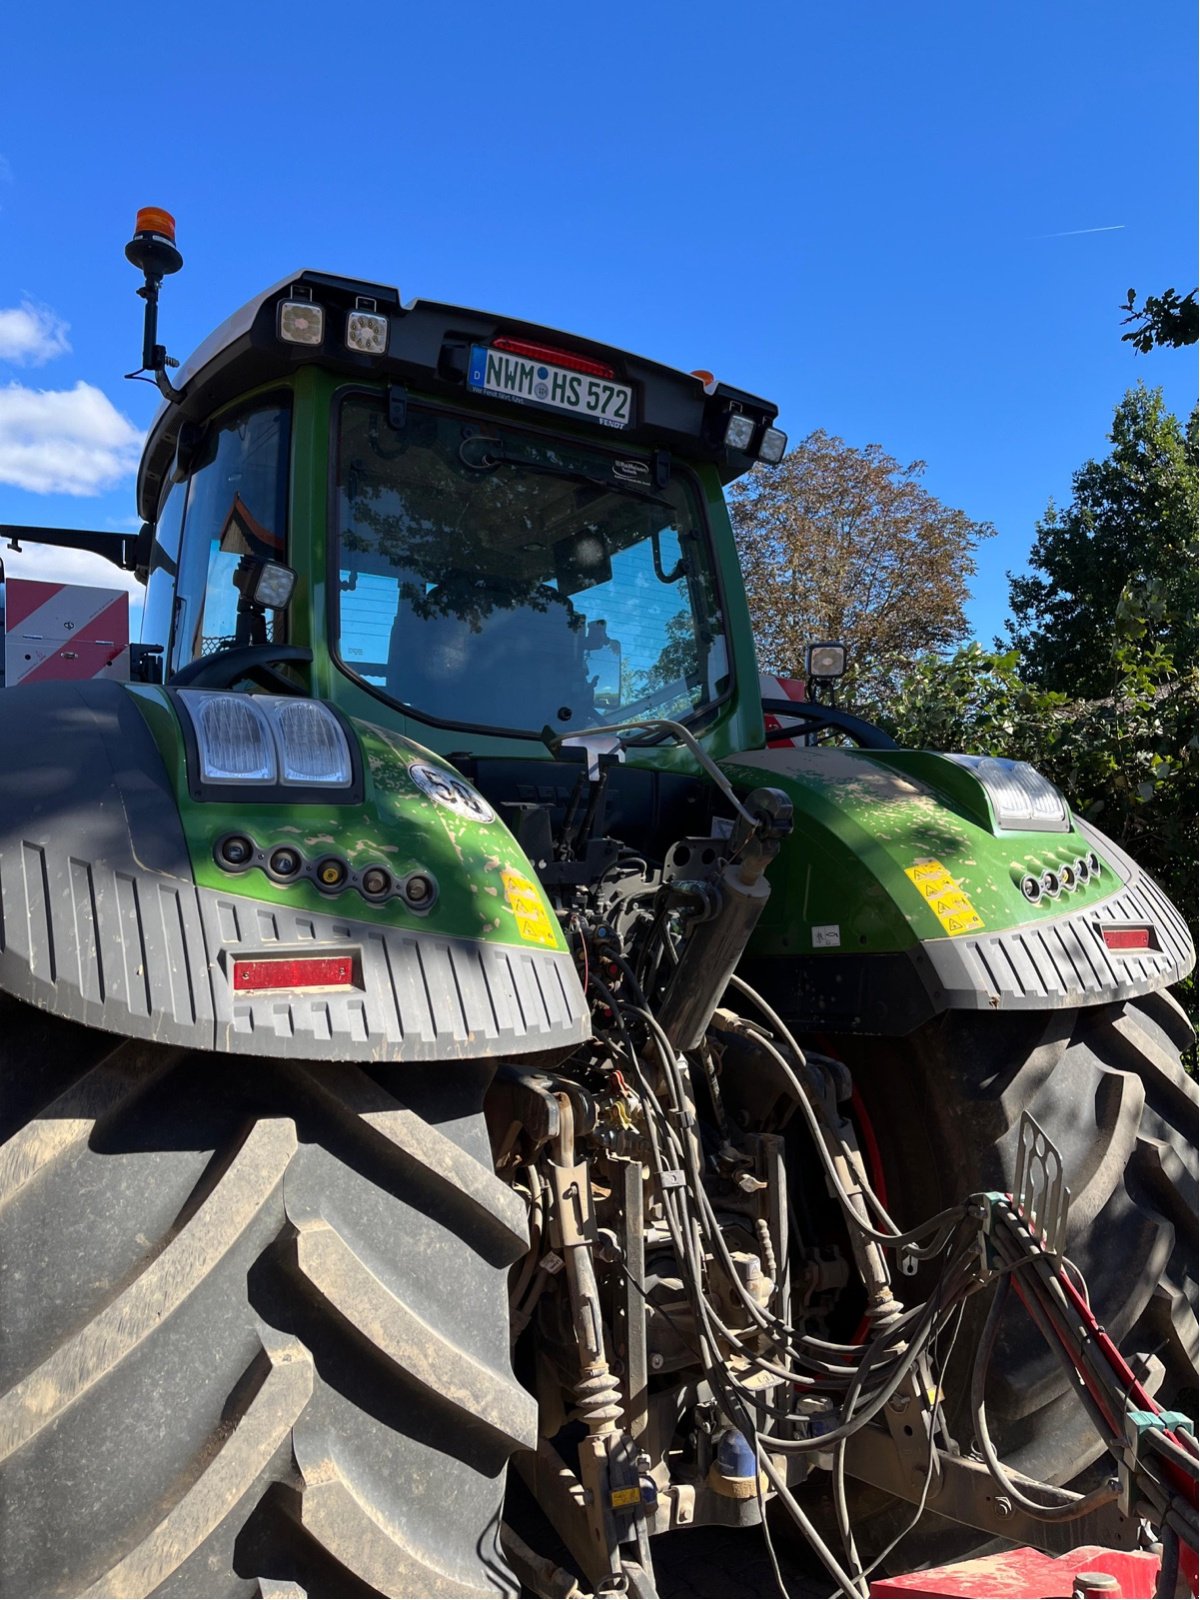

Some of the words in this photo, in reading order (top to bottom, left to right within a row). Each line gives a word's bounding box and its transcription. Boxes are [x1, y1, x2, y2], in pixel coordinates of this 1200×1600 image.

[473, 370, 481, 380] D
[486, 354, 535, 396] NWM
[551, 371, 582, 407] HS
[586, 381, 628, 419] 572
[599, 418, 625, 430] FENDT
[421, 768, 483, 815] 50
